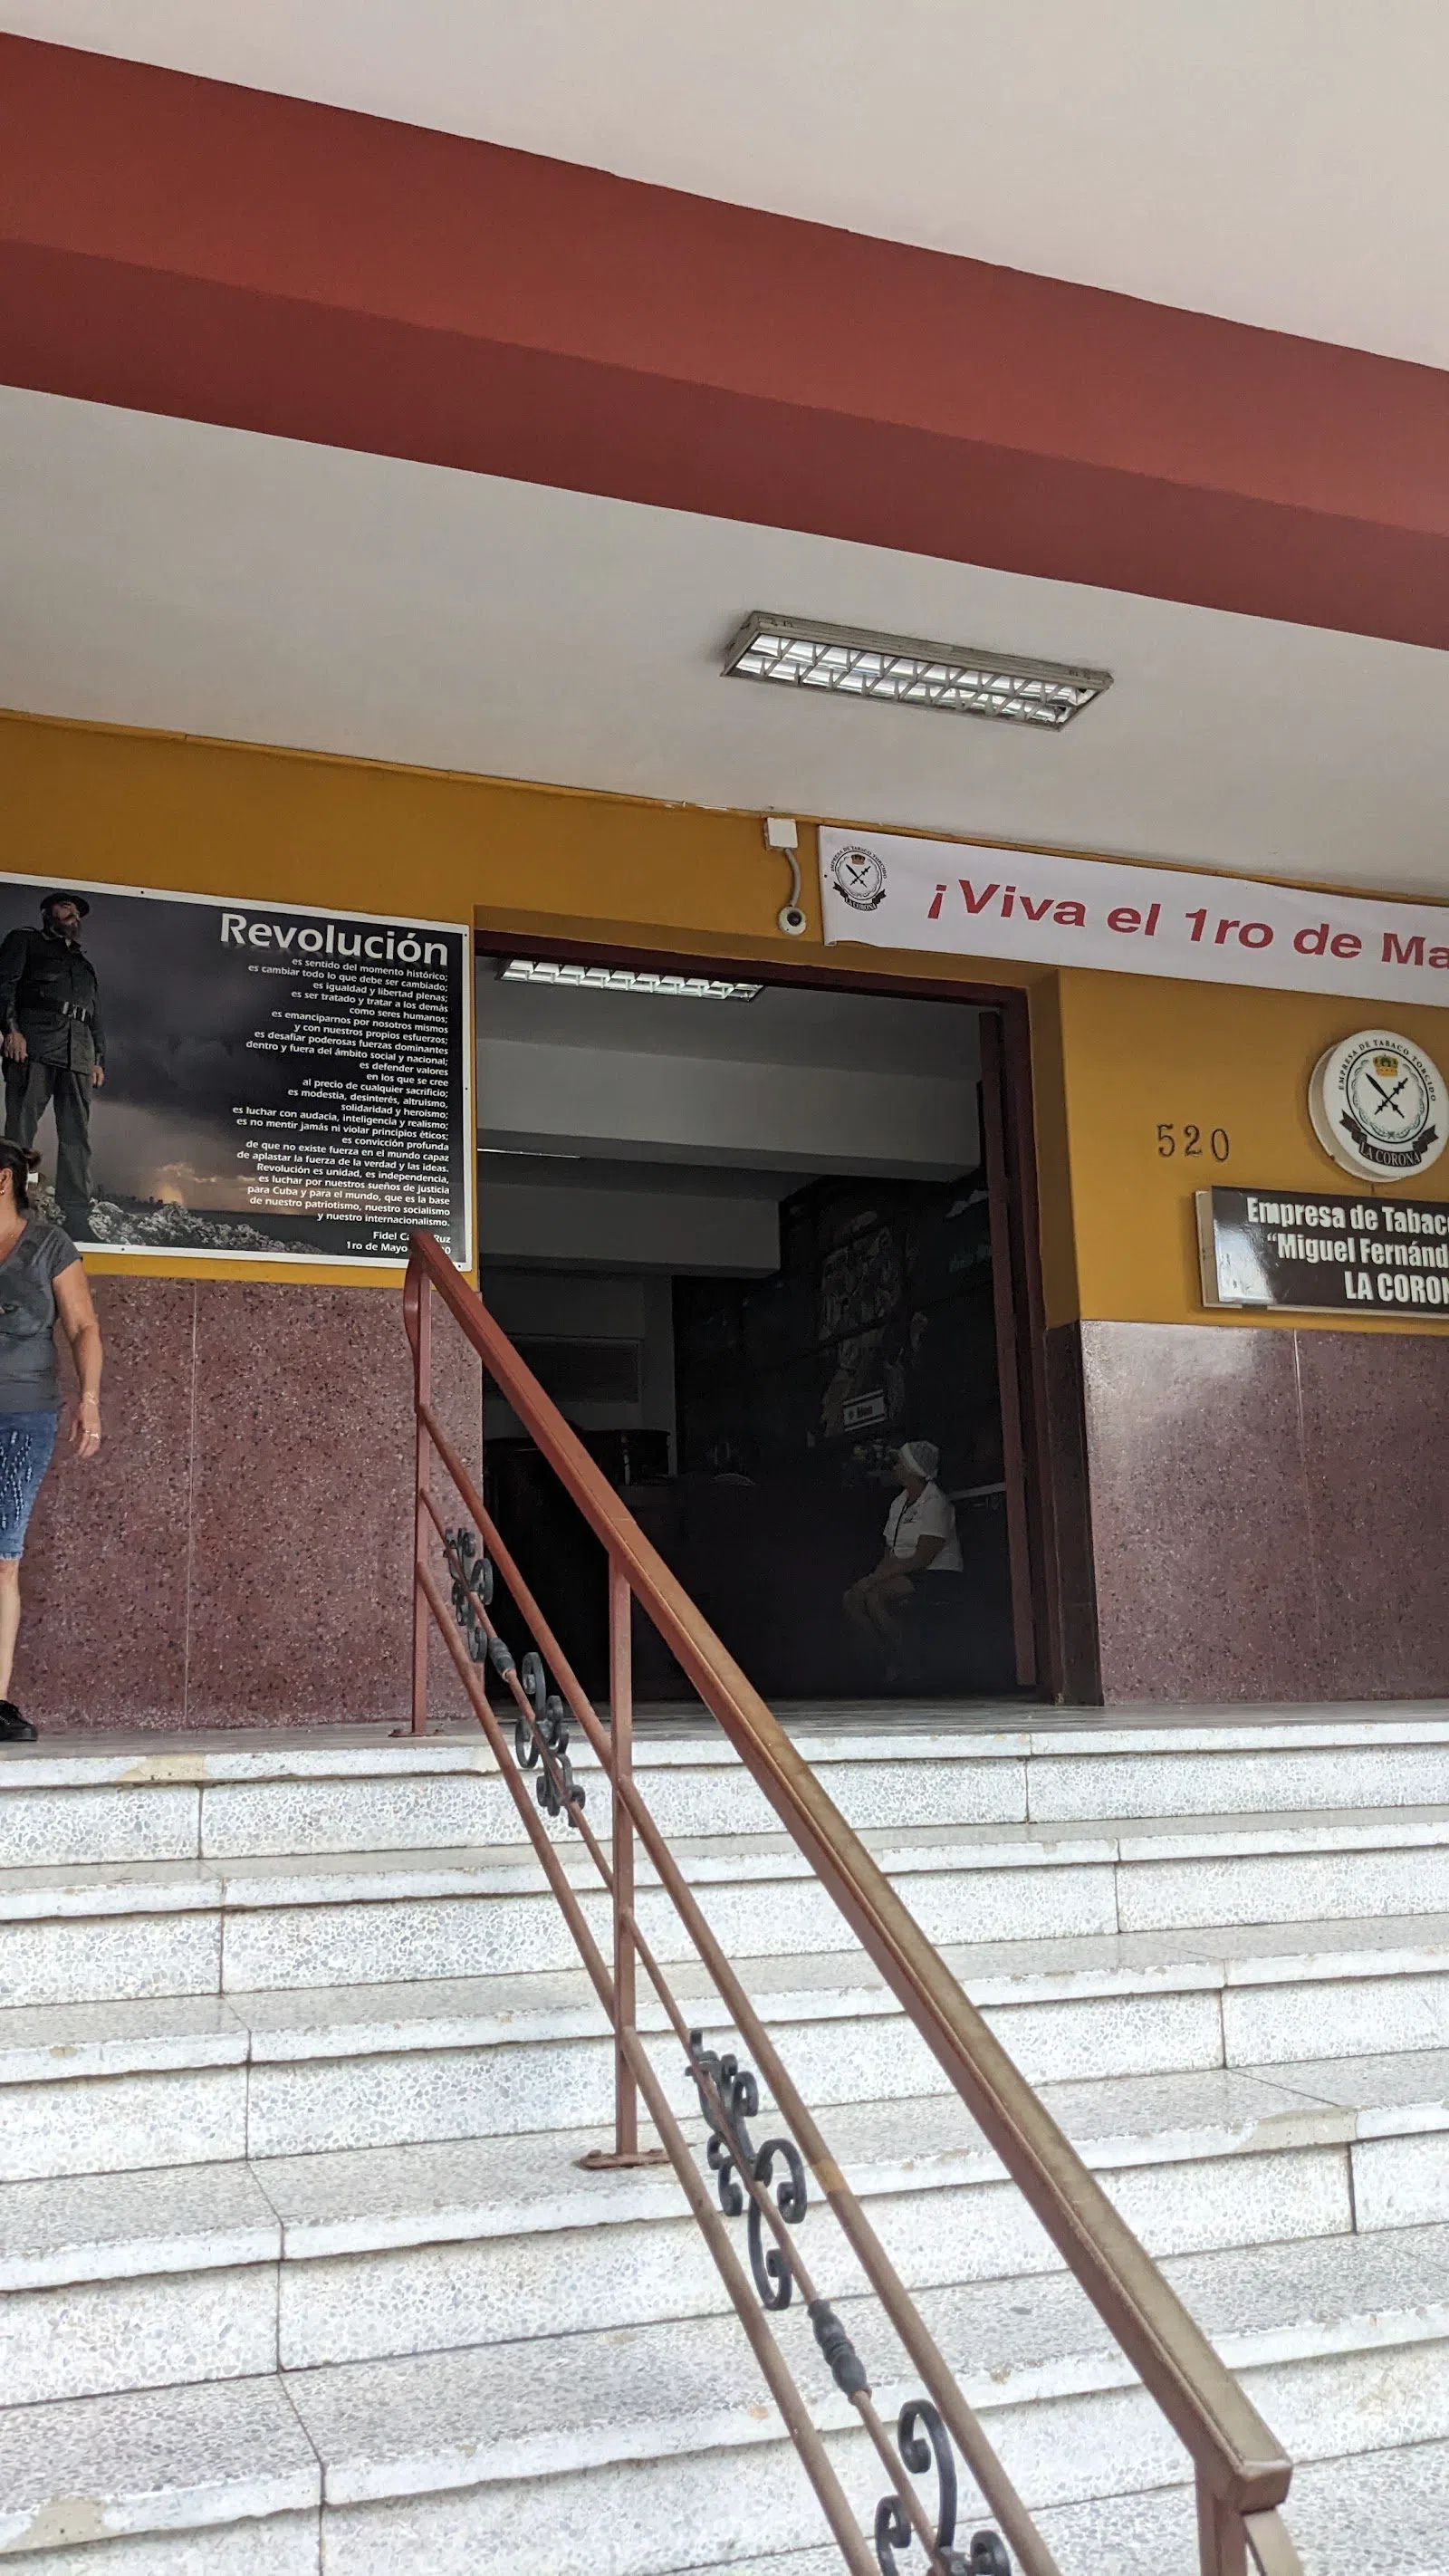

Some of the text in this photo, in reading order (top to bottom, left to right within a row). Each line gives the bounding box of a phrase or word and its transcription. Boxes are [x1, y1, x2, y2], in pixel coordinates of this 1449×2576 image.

[927, 879, 1449, 969] ¡Viva el 1ro de Ma
[220, 913, 448, 966] Revolución
[247, 965, 260, 973] es
[261, 966, 300, 976] cambiar
[302, 969, 325, 978] todo
[327, 971, 337, 980] lo
[339, 974, 357, 983] que
[359, 974, 382, 984] debe
[401, 980, 447, 992] cambiado;
[305, 960, 341, 970] sentido
[342, 962, 357, 971] del
[360, 966, 404, 976] momento
[406, 968, 448, 982] histórico;
[326, 982, 368, 994] igualdad
[369, 988, 376, 996] y
[378, 986, 413, 998] libertad
[416, 991, 448, 1003] plenas;
[284, 1012, 351, 1024] emanciparnos
[353, 1018, 369, 1027] por
[372, 1020, 412, 1030] nosotros
[415, 1023, 448, 1033] mismos
[349, 1007, 448, 1024] como seres humanos;
[267, 1031, 306, 1042] desafiar
[308, 1034, 357, 1046] poderosas
[359, 1038, 392, 1049] fuerzas
[394, 1041, 448, 1053] dominantes
[294, 1024, 447, 1044] y con nuestros propios esfuerzos;
[246, 1040, 448, 1066] dentro y fuera del ámbito social y nacional;
[371, 1062, 415, 1072] defender
[416, 1065, 448, 1075] valores
[380, 1073, 395, 1082] los
[397, 1076, 415, 1085] que
[1339, 1039, 1435, 1101] EMPRESA DE TABACO TORCIDO
[302, 1078, 448, 1098] al precio de cualquier sacrificio;
[301, 1090, 347, 1101] modestia,
[402, 1096, 448, 1109] altruismo,
[245, 1106, 277, 1117] luchar
[300, 1110, 340, 1122] audacia,
[342, 1113, 397, 1125] inteligencia
[399, 1119, 406, 1128] y
[408, 1119, 449, 1129] realismo;
[245, 1139, 259, 1149] de
[261, 1142, 280, 1151] que
[299, 1144, 326, 1153] existe
[329, 1145, 359, 1155] fuerza
[376, 1149, 385, 1157] el
[388, 1150, 420, 1158] mundo
[423, 1153, 449, 1162] capaz
[354, 1138, 404, 1148] convicción
[406, 1140, 449, 1150] profunda
[1156, 1123, 1230, 1162] 520
[236, 1150, 449, 1171] de aplastar la fuerza de la verdad y las ideas.
[1360, 1141, 1421, 1167] LA CORONA
[256, 1162, 311, 1174] Revolución
[326, 1168, 362, 1178] unidad,
[378, 1170, 449, 1184] independencia,
[272, 1175, 302, 1185] luchar
[305, 1178, 322, 1187] por
[325, 1179, 365, 1188] nuestros
[368, 1181, 400, 1190] sueños
[403, 1183, 415, 1191] de
[417, 1184, 449, 1194] justicia
[247, 1187, 270, 1196] para
[273, 1187, 298, 1197] Cuba
[300, 1190, 307, 1199] y
[309, 1190, 331, 1199] para
[333, 1190, 342, 1198] el
[345, 1192, 381, 1202] mundo,
[384, 1195, 403, 1204] que
[418, 1195, 426, 1203] la
[429, 1195, 450, 1205] base
[250, 1196, 450, 1215] de nuestro patriotismo, nuestro socialismo
[317, 1214, 323, 1223] y
[365, 1215, 450, 1226] internacionalismo.
[1246, 1197, 1449, 1235] Empresa de Tabac
[373, 1232, 397, 1241] Fidel
[346, 1241, 408, 1254] 1ro de Mayo
[1344, 1271, 1375, 1301] LA
